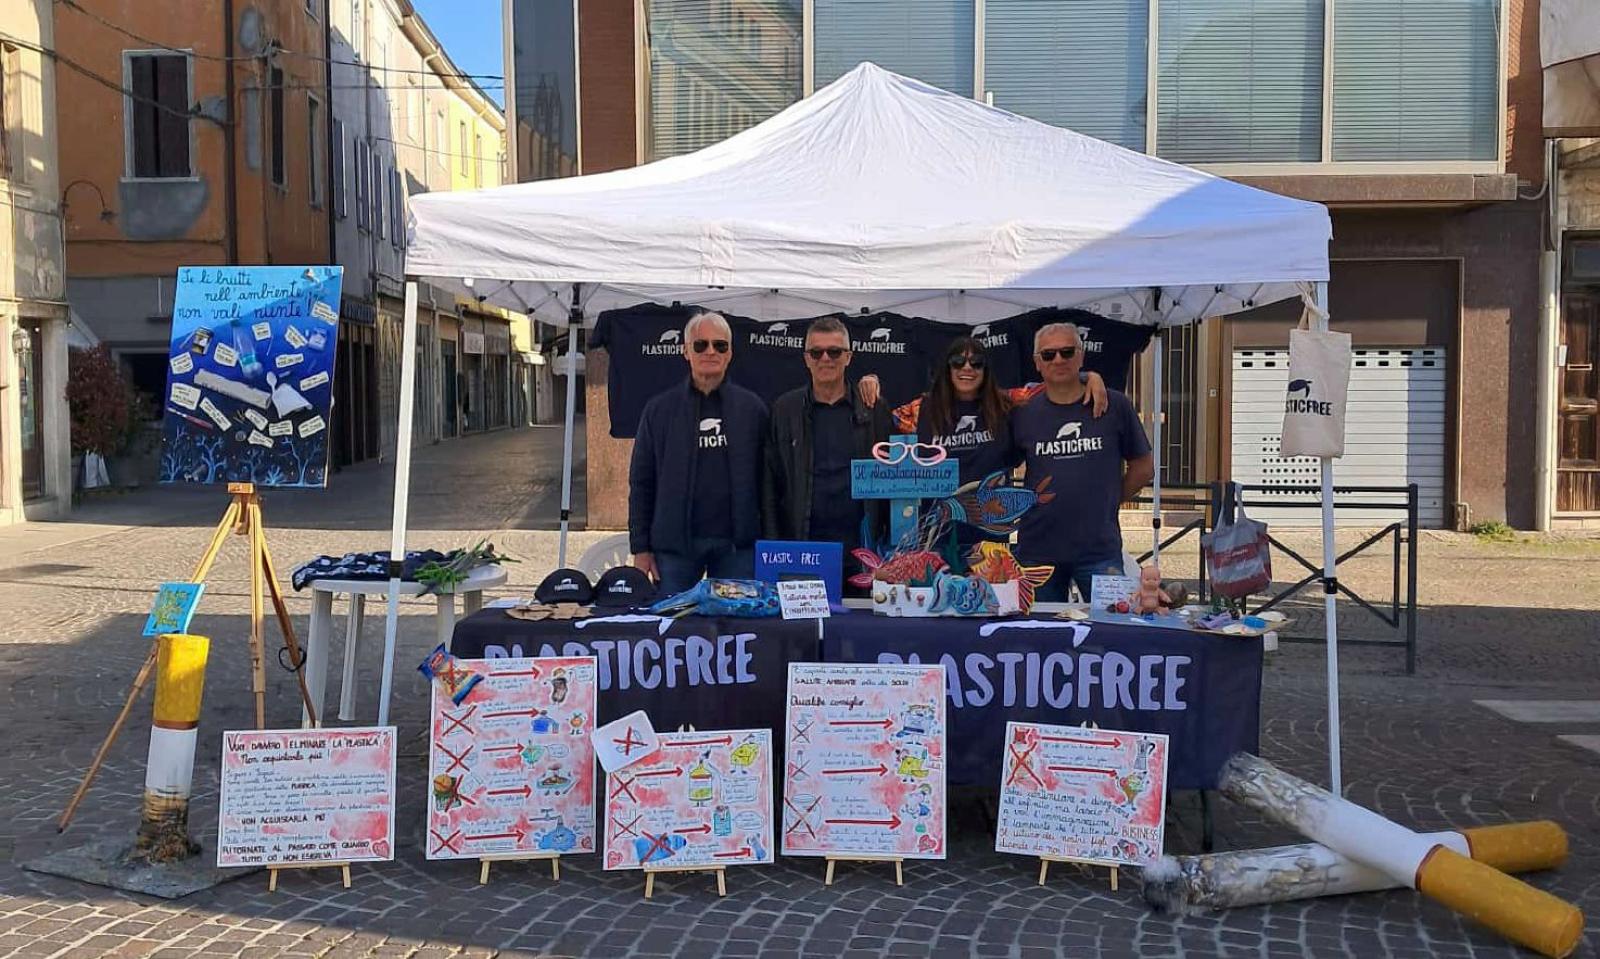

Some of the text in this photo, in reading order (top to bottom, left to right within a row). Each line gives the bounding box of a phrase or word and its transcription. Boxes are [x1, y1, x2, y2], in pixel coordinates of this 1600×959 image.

[177, 308, 202, 318] non
[212, 302, 242, 319] vali
[254, 299, 301, 318] niente
[750, 333, 804, 348] PLASTICFREE
[852, 341, 906, 354] PLASTICFREE
[1035, 437, 1103, 456] PLASTICFREE
[762, 552, 821, 566] PLASTIC FREE
